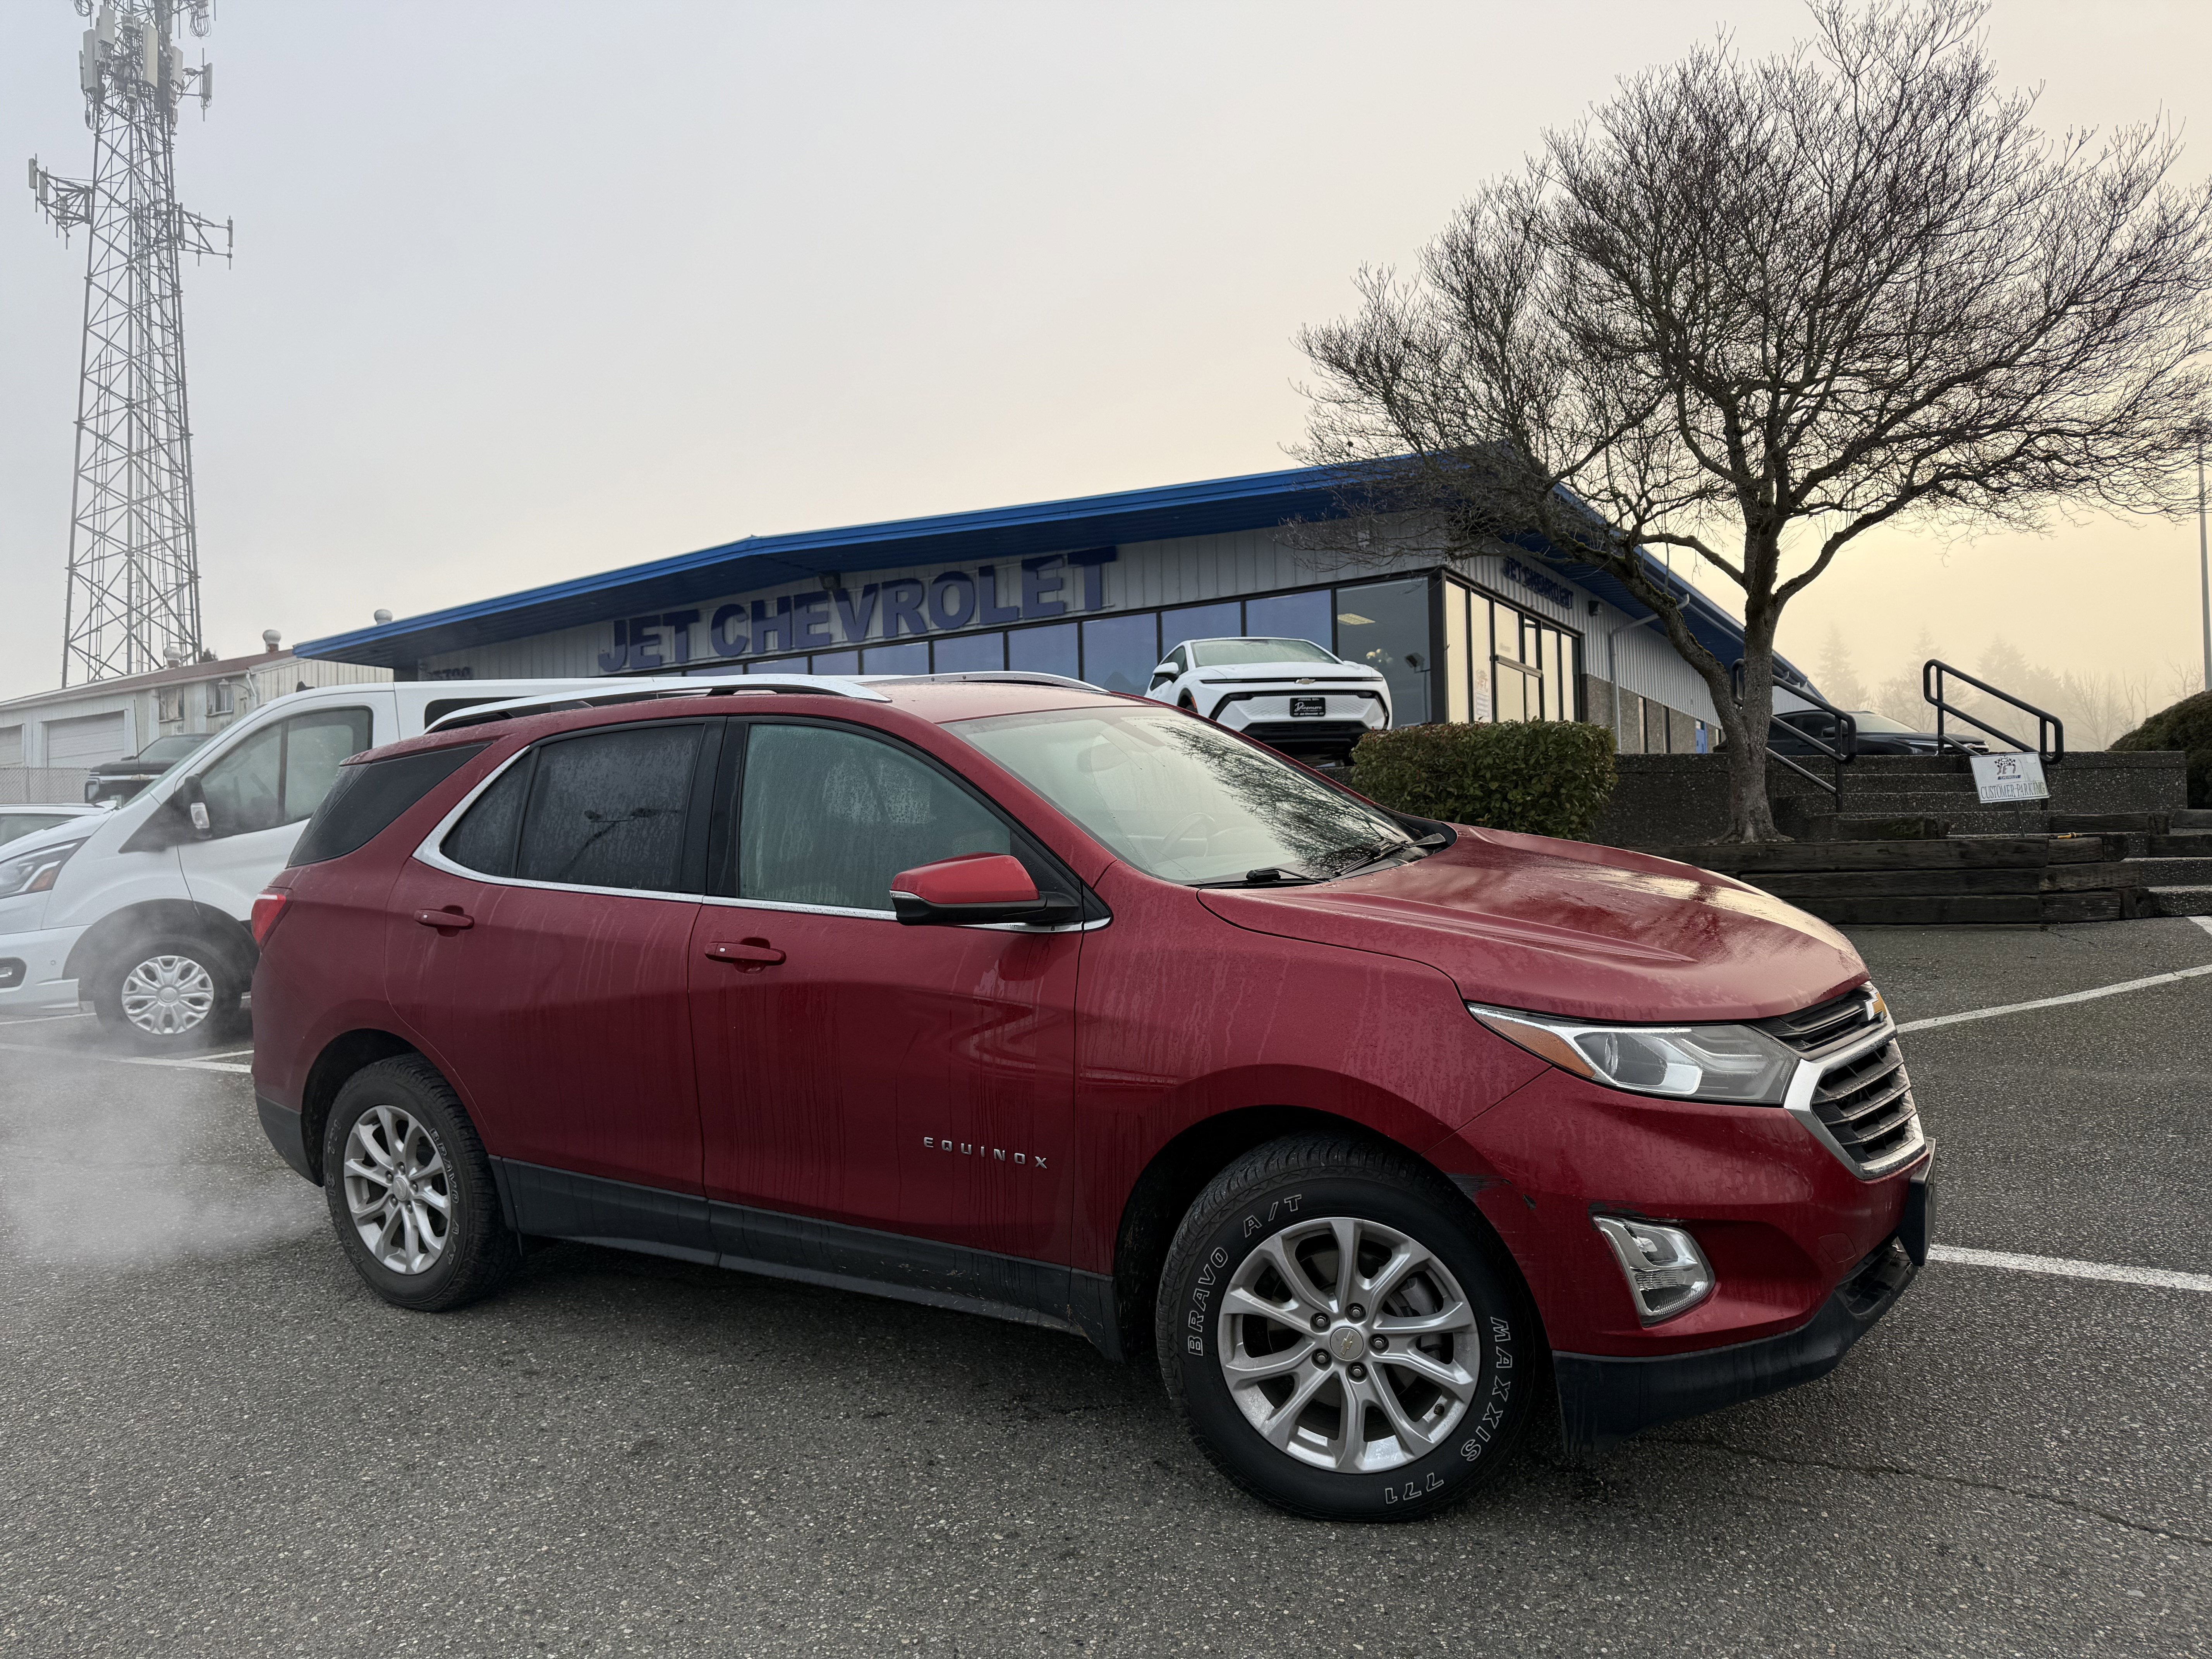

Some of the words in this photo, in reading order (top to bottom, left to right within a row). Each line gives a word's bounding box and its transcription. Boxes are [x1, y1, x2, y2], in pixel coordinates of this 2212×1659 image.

[1503, 555, 1522, 582] JET
[598, 609, 700, 672] JET
[711, 545, 1117, 657] CHEVROLET
[429, 1128, 459, 1203] BRAVO
[924, 1137, 1048, 1169] EQUINOX
[1187, 1247, 1228, 1356] BRAVO
[1243, 1194, 1302, 1238] A/T
[1460, 1316, 1513, 1462] MAXXIS
[1385, 1472, 1444, 1504] 771
